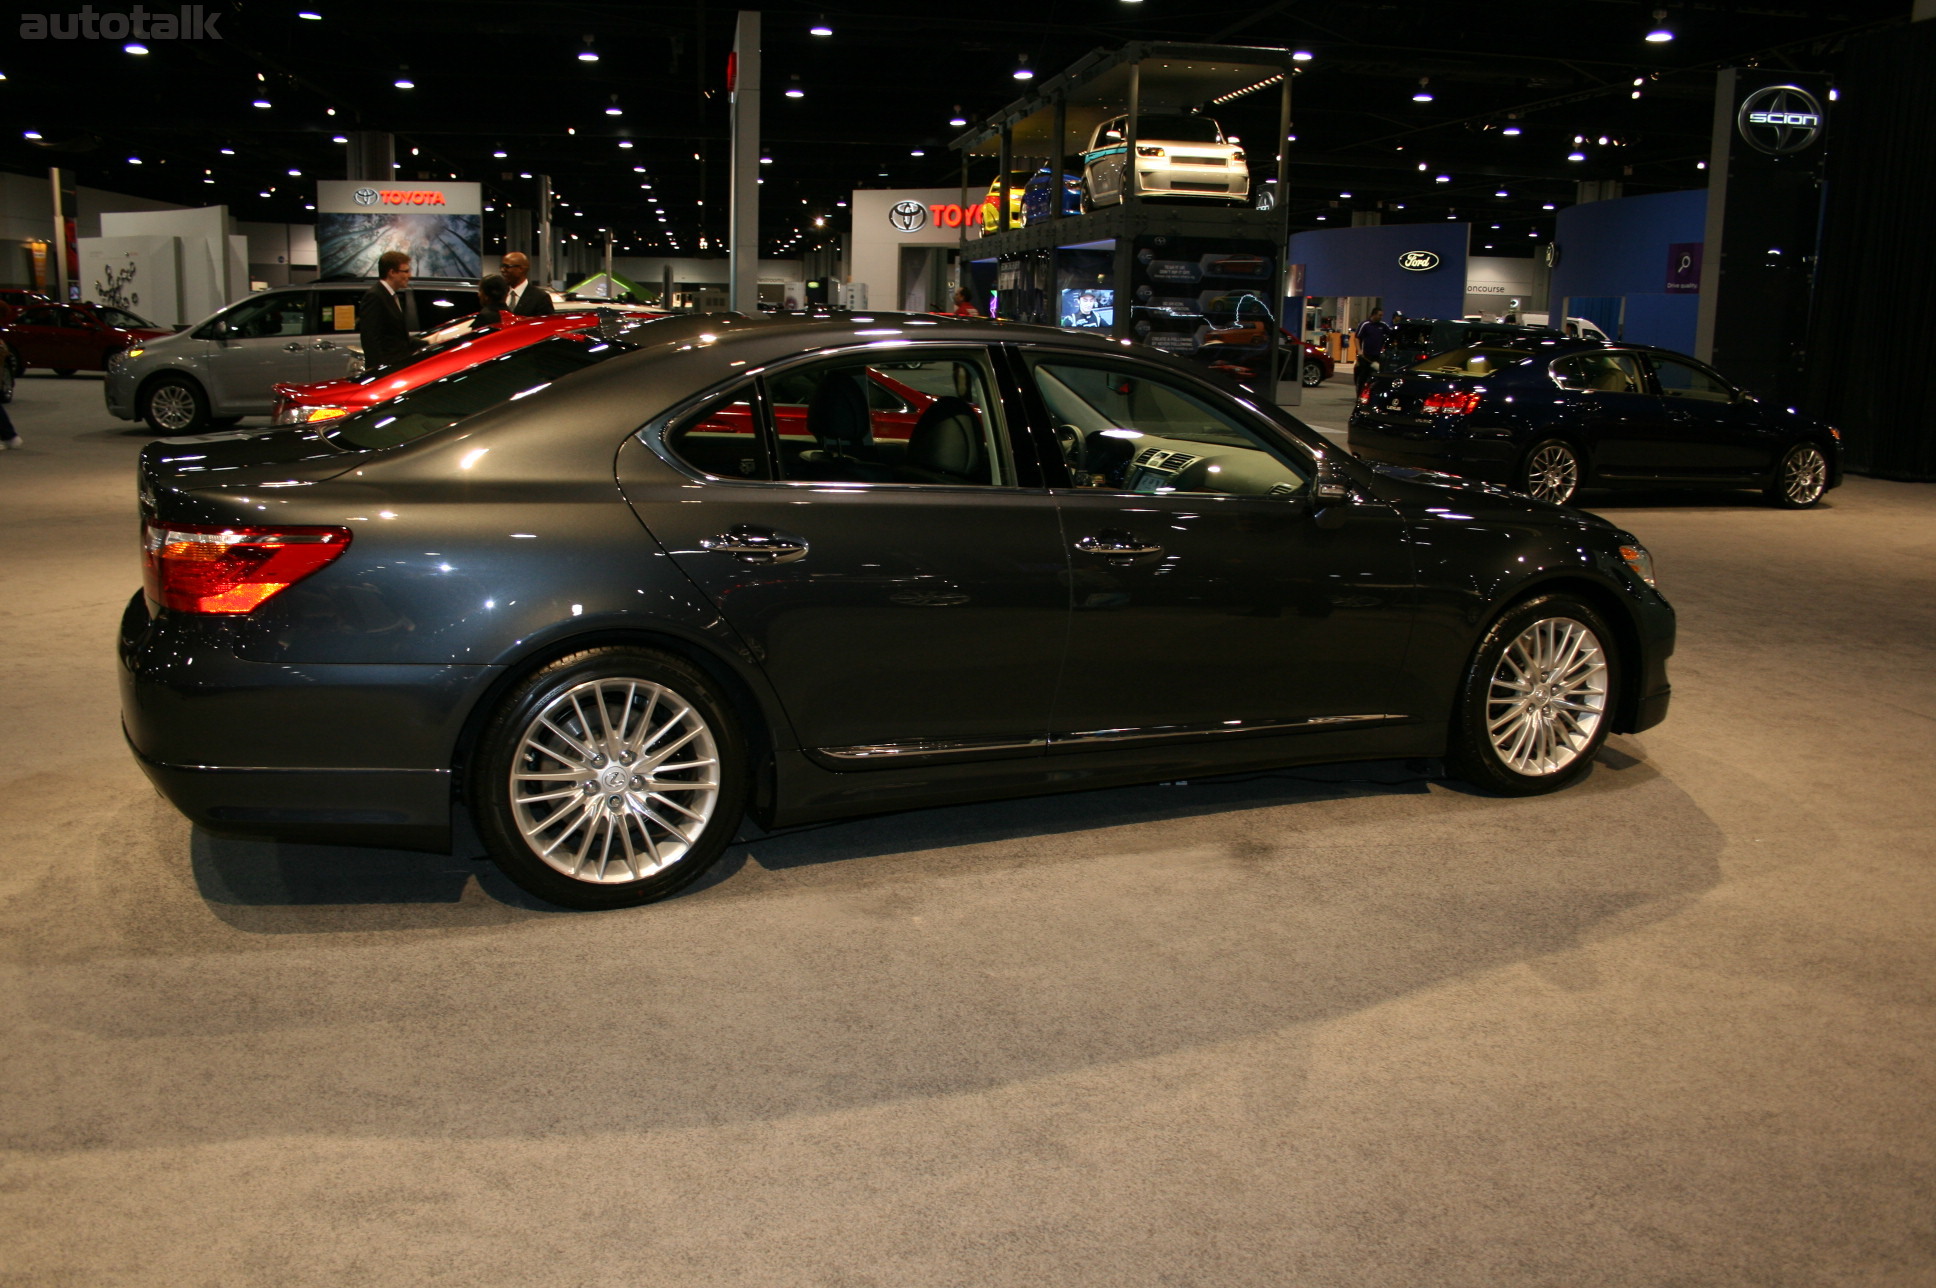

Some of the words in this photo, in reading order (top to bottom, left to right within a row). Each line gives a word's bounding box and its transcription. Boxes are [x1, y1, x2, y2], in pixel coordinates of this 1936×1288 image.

[1749, 113, 1818, 126] SCION
[380, 189, 446, 205] TOYOTA
[1404, 253, 1431, 267] Ford
[1466, 285, 1505, 294] oncourse
